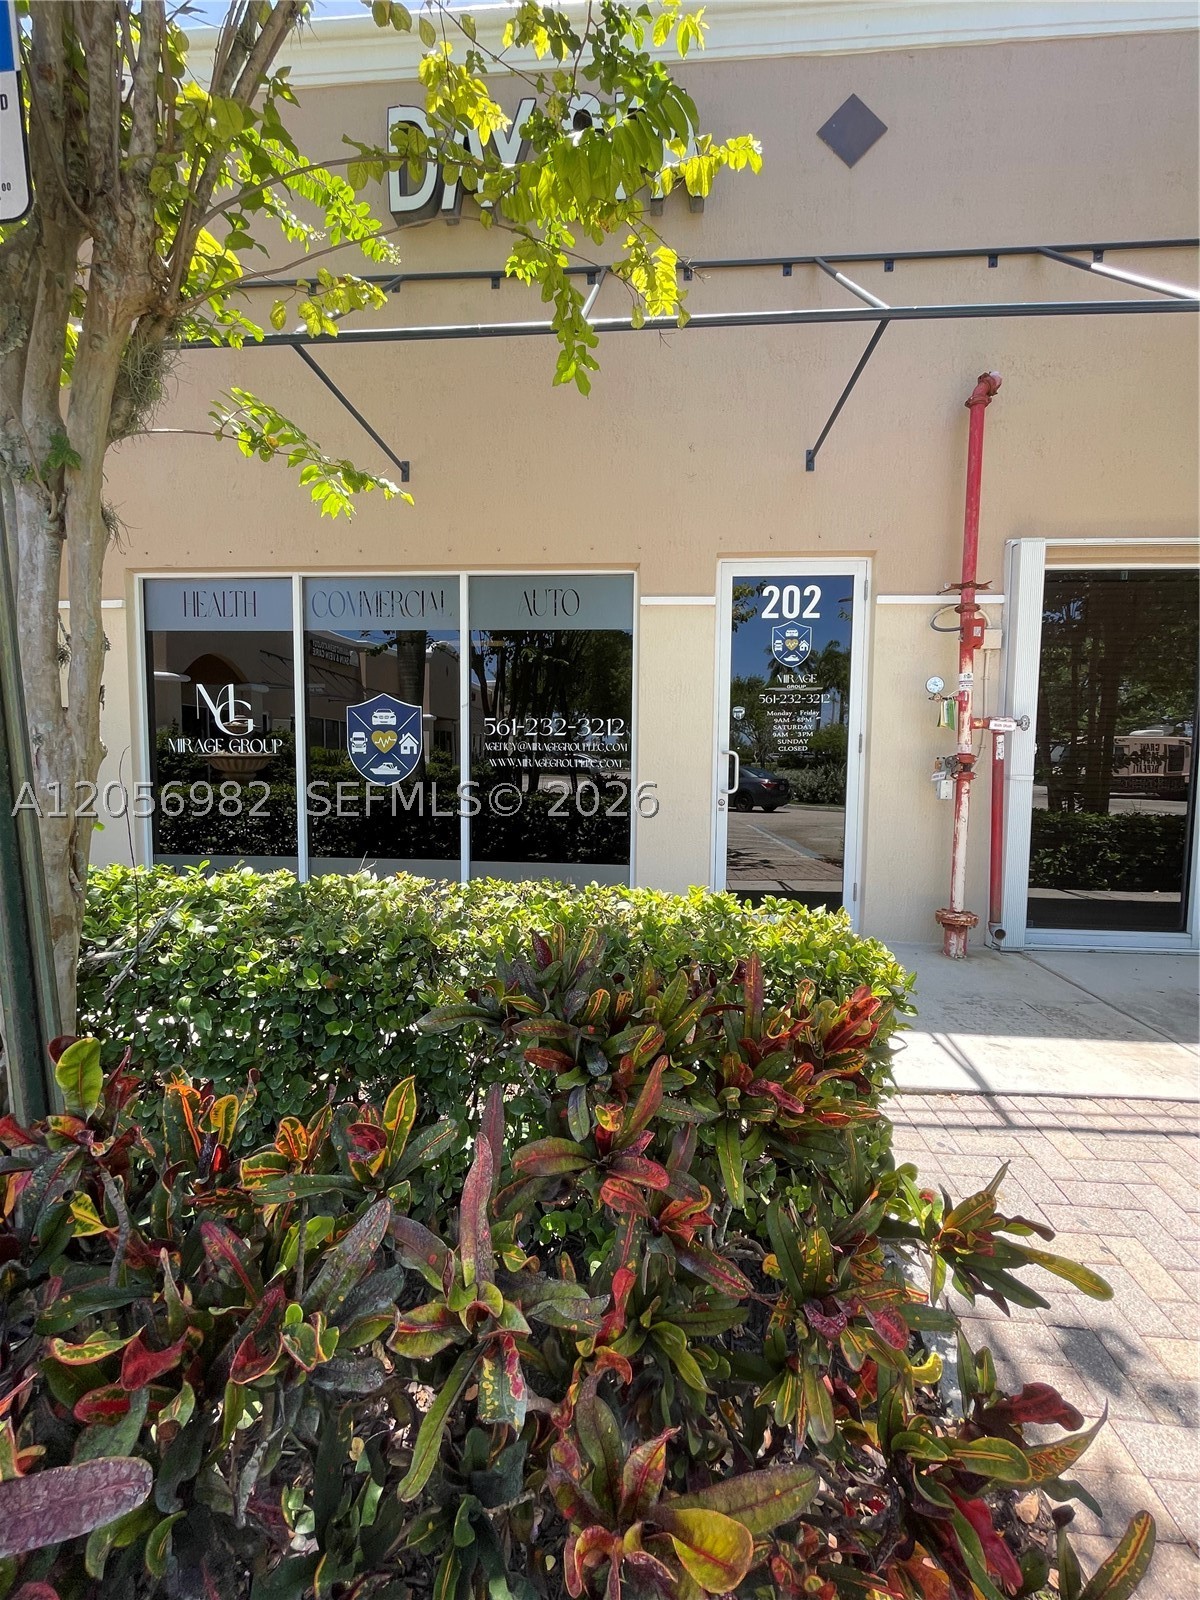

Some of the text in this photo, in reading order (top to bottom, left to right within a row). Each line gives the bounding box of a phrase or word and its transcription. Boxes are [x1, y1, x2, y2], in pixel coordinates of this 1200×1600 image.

[183, 590, 257, 618] HEALTH
[518, 588, 580, 617] AUTO
[761, 584, 822, 619] 202
[777, 673, 818, 683] MIRAGE
[758, 693, 830, 704] 561-232-3212
[483, 717, 625, 737] 561-232-3212
[168, 738, 283, 754] MIRAGE GROUP
